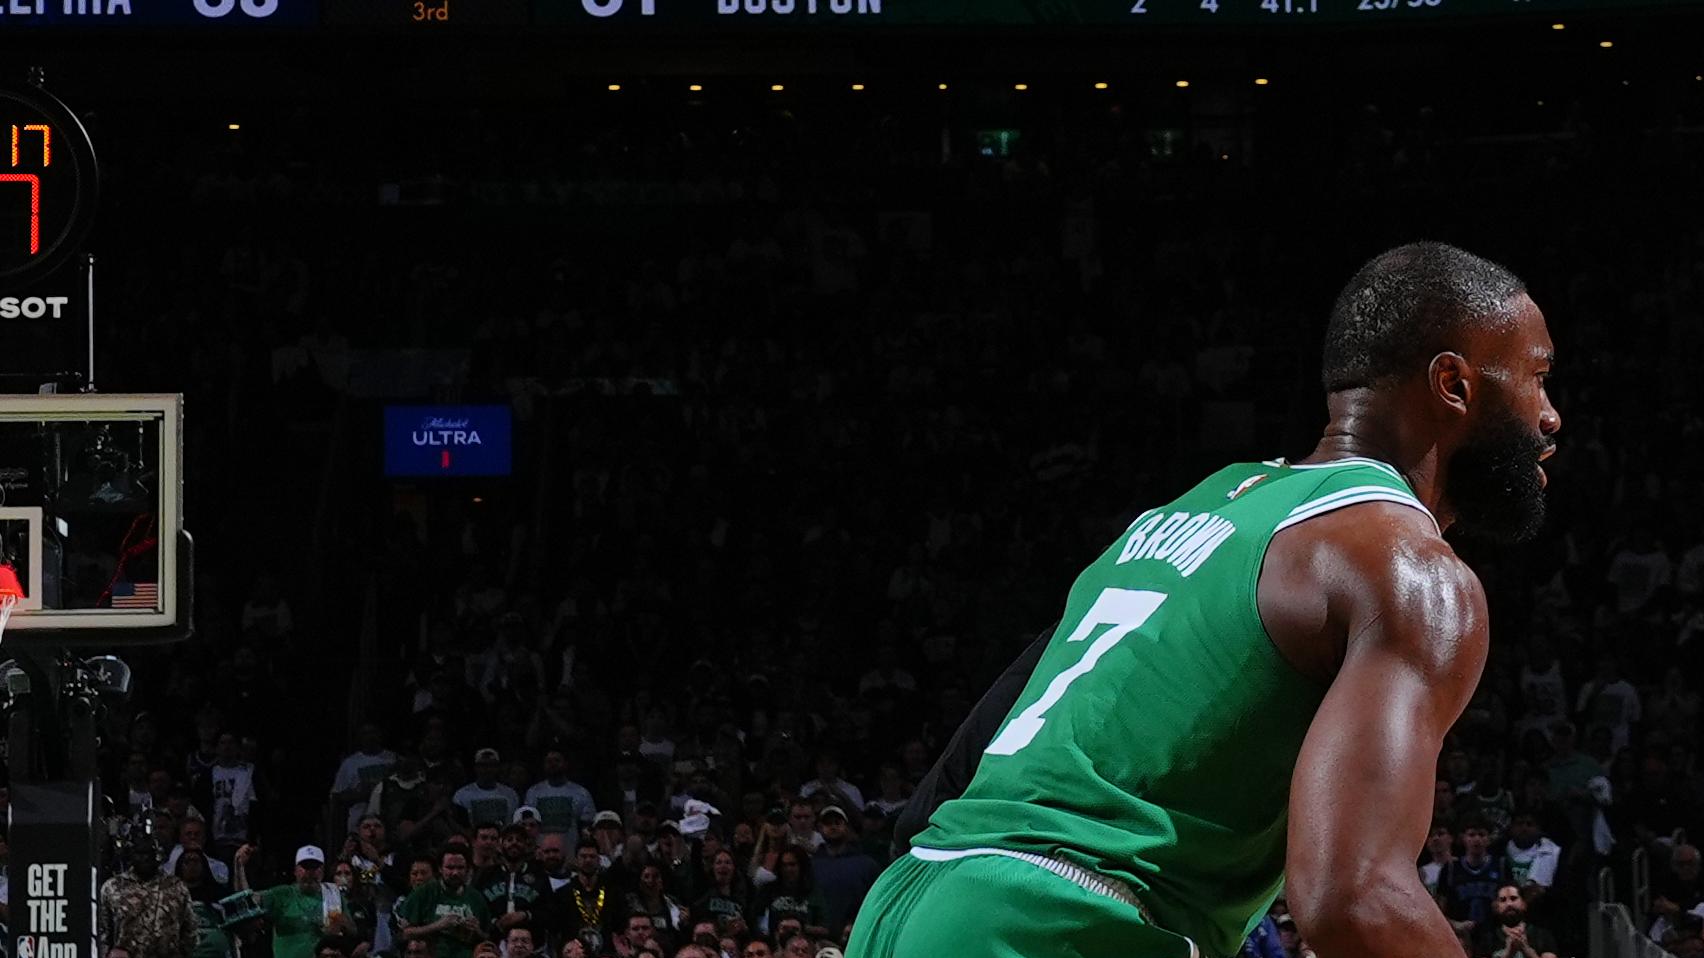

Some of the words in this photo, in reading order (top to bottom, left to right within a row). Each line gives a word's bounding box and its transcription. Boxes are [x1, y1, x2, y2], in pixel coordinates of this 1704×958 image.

[413, 1, 449, 21] 3rd
[412, 430, 482, 446] ULTRA
[983, 586, 1168, 756] 7
[27, 863, 68, 898] GET
[26, 899, 68, 933] THE
